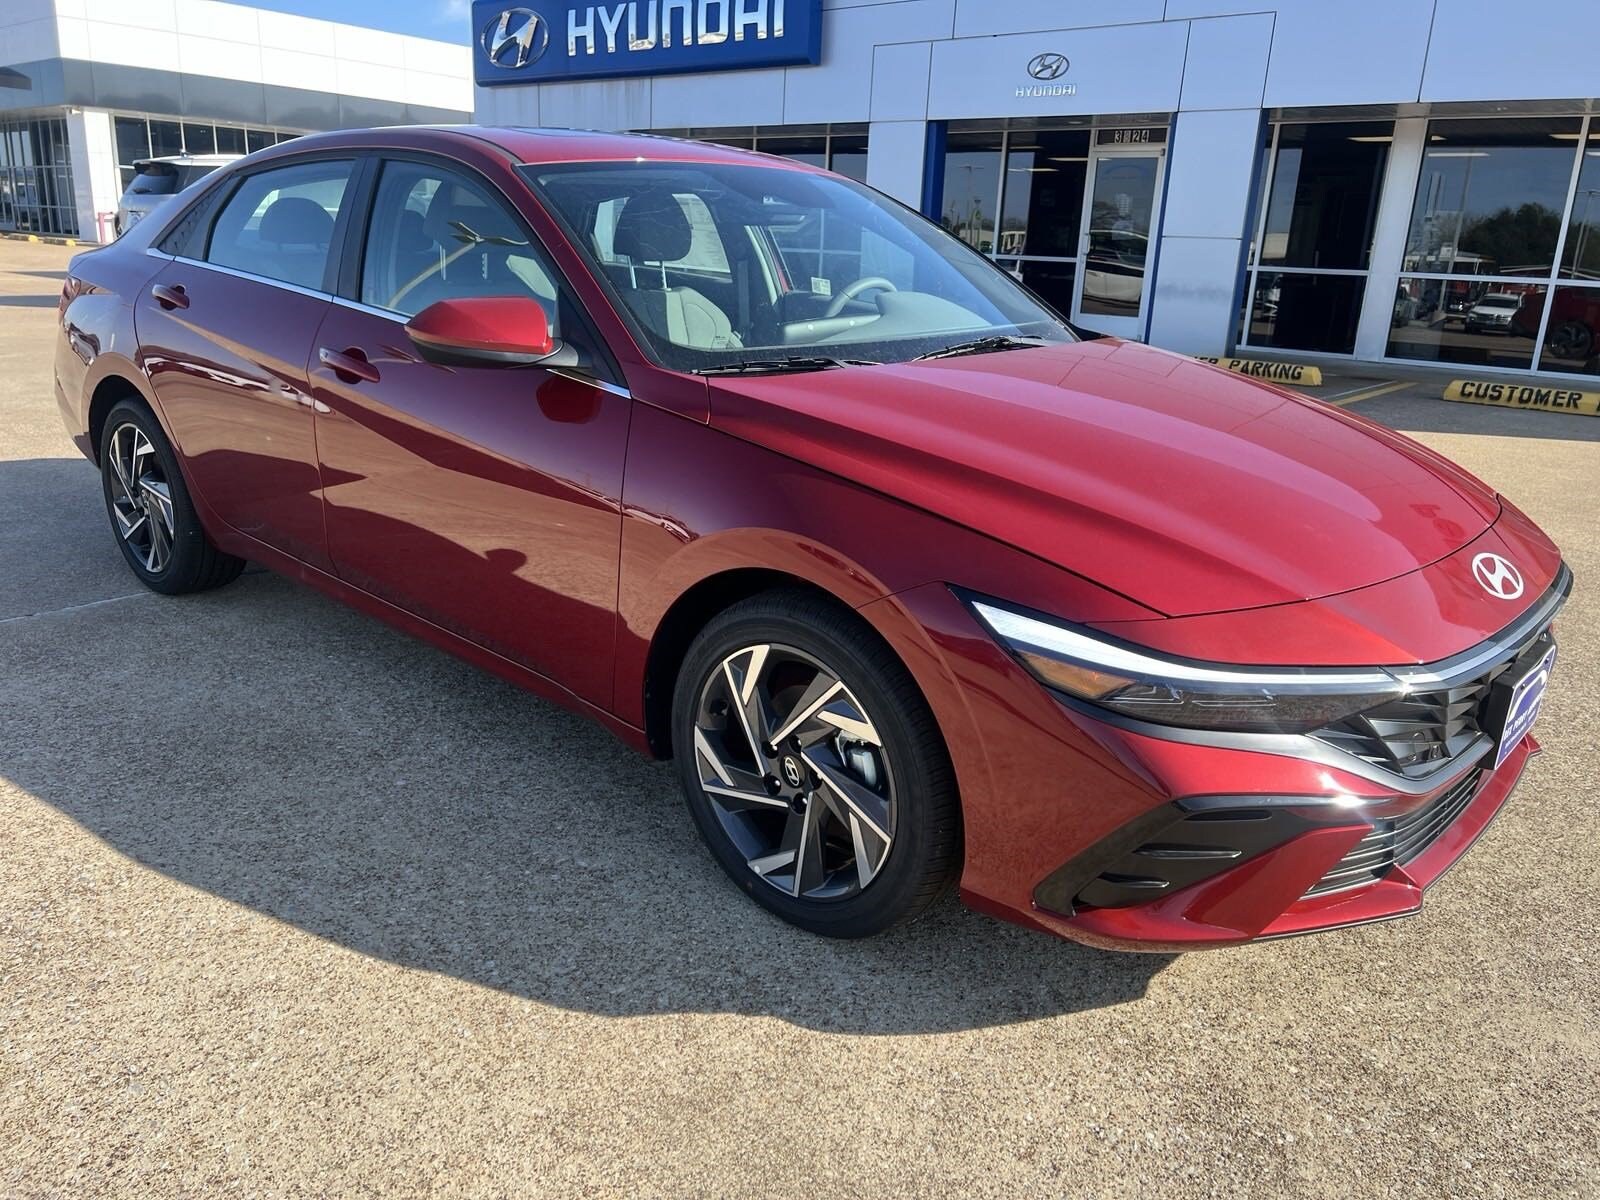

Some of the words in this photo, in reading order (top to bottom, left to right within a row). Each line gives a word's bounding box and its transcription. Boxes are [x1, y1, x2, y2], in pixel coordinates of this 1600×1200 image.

[567, 0, 785, 56] HYUNDAI
[1015, 84, 1077, 97] HYUNDAI
[1228, 359, 1304, 381] PARKING
[1460, 381, 1583, 409] CUSTOMER
